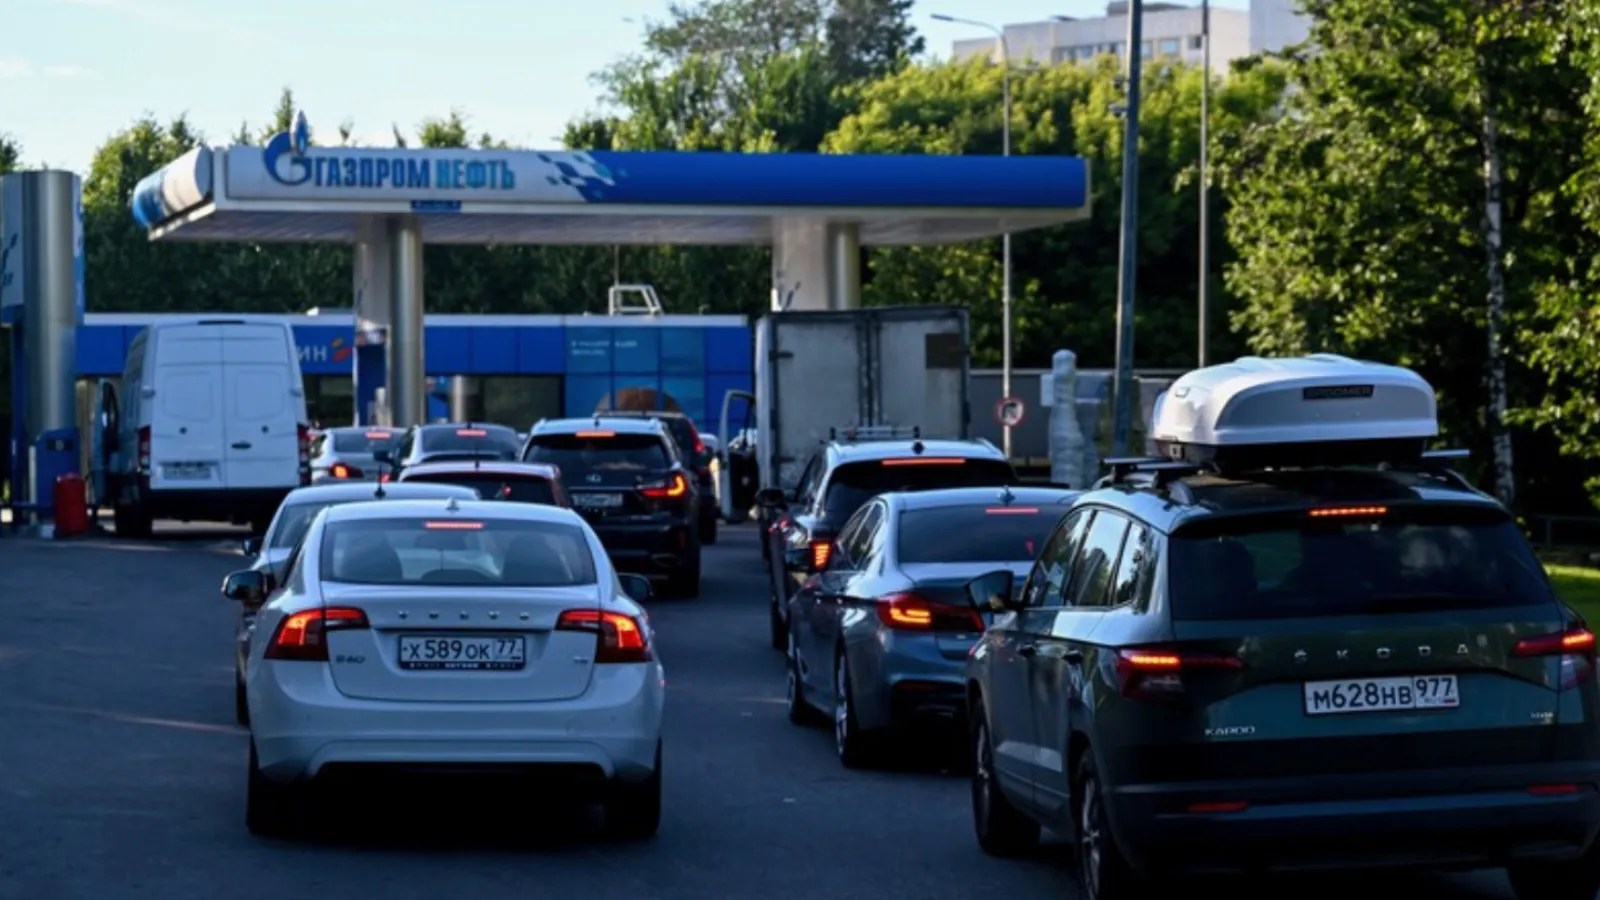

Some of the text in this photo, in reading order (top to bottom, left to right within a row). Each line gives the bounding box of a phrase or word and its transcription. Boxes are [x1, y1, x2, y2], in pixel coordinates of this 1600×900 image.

[314, 157, 516, 190] ГАЗПРОМ НЕФТЬ
[497, 639, 517, 655] 77
[1313, 677, 1455, 710] М628НВ 977
